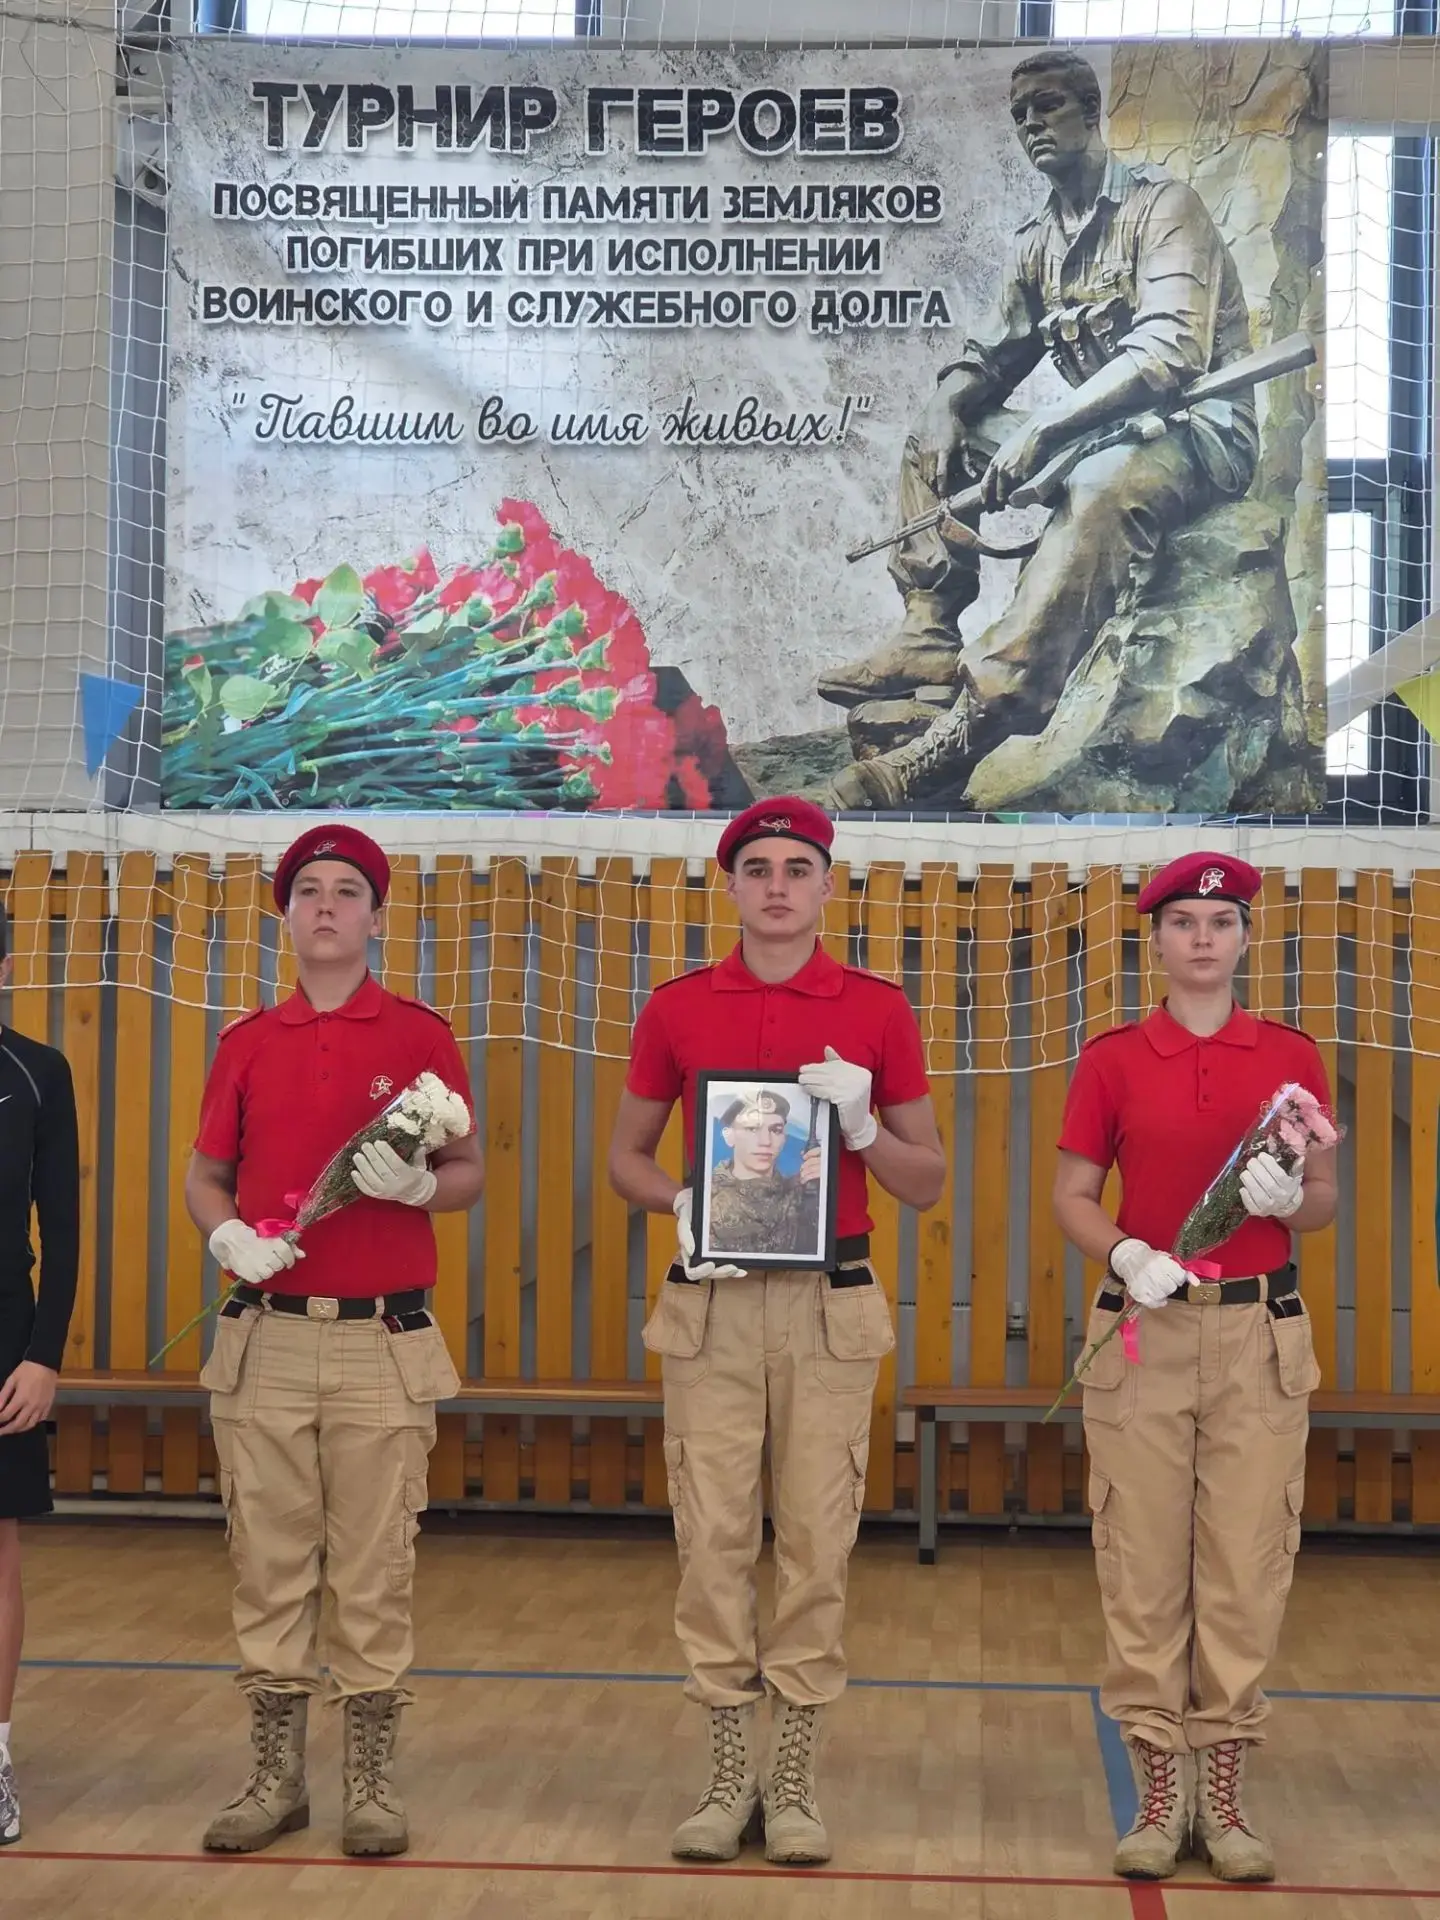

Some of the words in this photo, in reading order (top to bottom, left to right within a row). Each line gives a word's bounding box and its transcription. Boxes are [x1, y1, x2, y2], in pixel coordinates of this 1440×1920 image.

[252, 83, 557, 150] ТУРНИР
[587, 87, 902, 154] ГЕРОЕВ
[214, 178, 528, 225] ПОСВЯЩЕННЫЙ
[543, 185, 708, 219] ПАМЯТИ
[723, 185, 943, 219] ЗЕМЛЯКОВ
[286, 237, 504, 271] ПОГИБШИХ
[519, 238, 594, 272] ПРИ
[608, 238, 881, 272] ИСПОЛНЕНИИ
[203, 287, 451, 322] ВОИНСКОГО
[469, 291, 492, 322] И
[508, 291, 794, 324] СЛУЖЕБНОГО
[811, 291, 951, 332] ДОЛГА
[479, 395, 536, 441] во
[552, 413, 648, 442] имя
